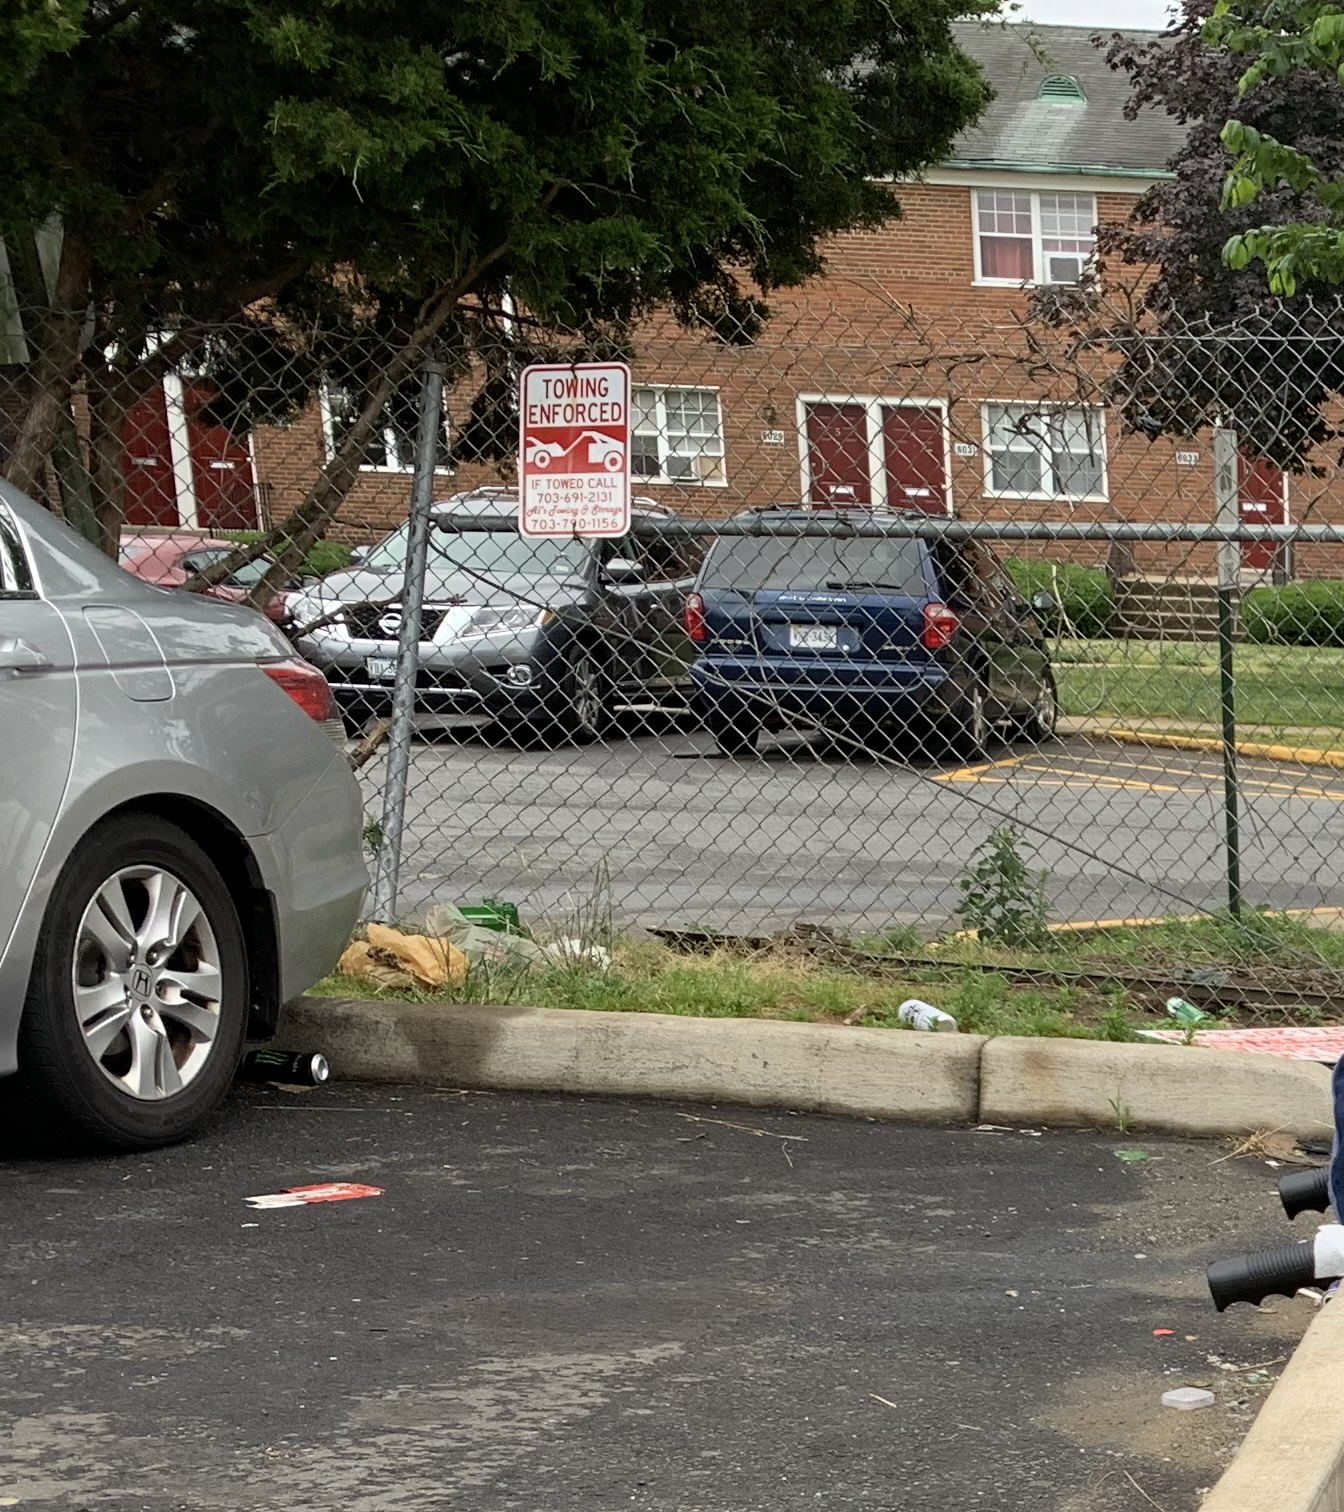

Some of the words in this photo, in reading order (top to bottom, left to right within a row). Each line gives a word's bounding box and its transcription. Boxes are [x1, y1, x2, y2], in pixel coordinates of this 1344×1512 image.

[543, 377, 609, 399] TOWING
[529, 402, 622, 424] ENFORCED
[531, 479, 541, 490] IF
[546, 478, 584, 490] TOWED
[588, 477, 618, 489] CALL
[537, 491, 613, 504] 703-691-2131
[548, 505, 579, 517] Towing
[531, 518, 618, 530] 703-790-1156
